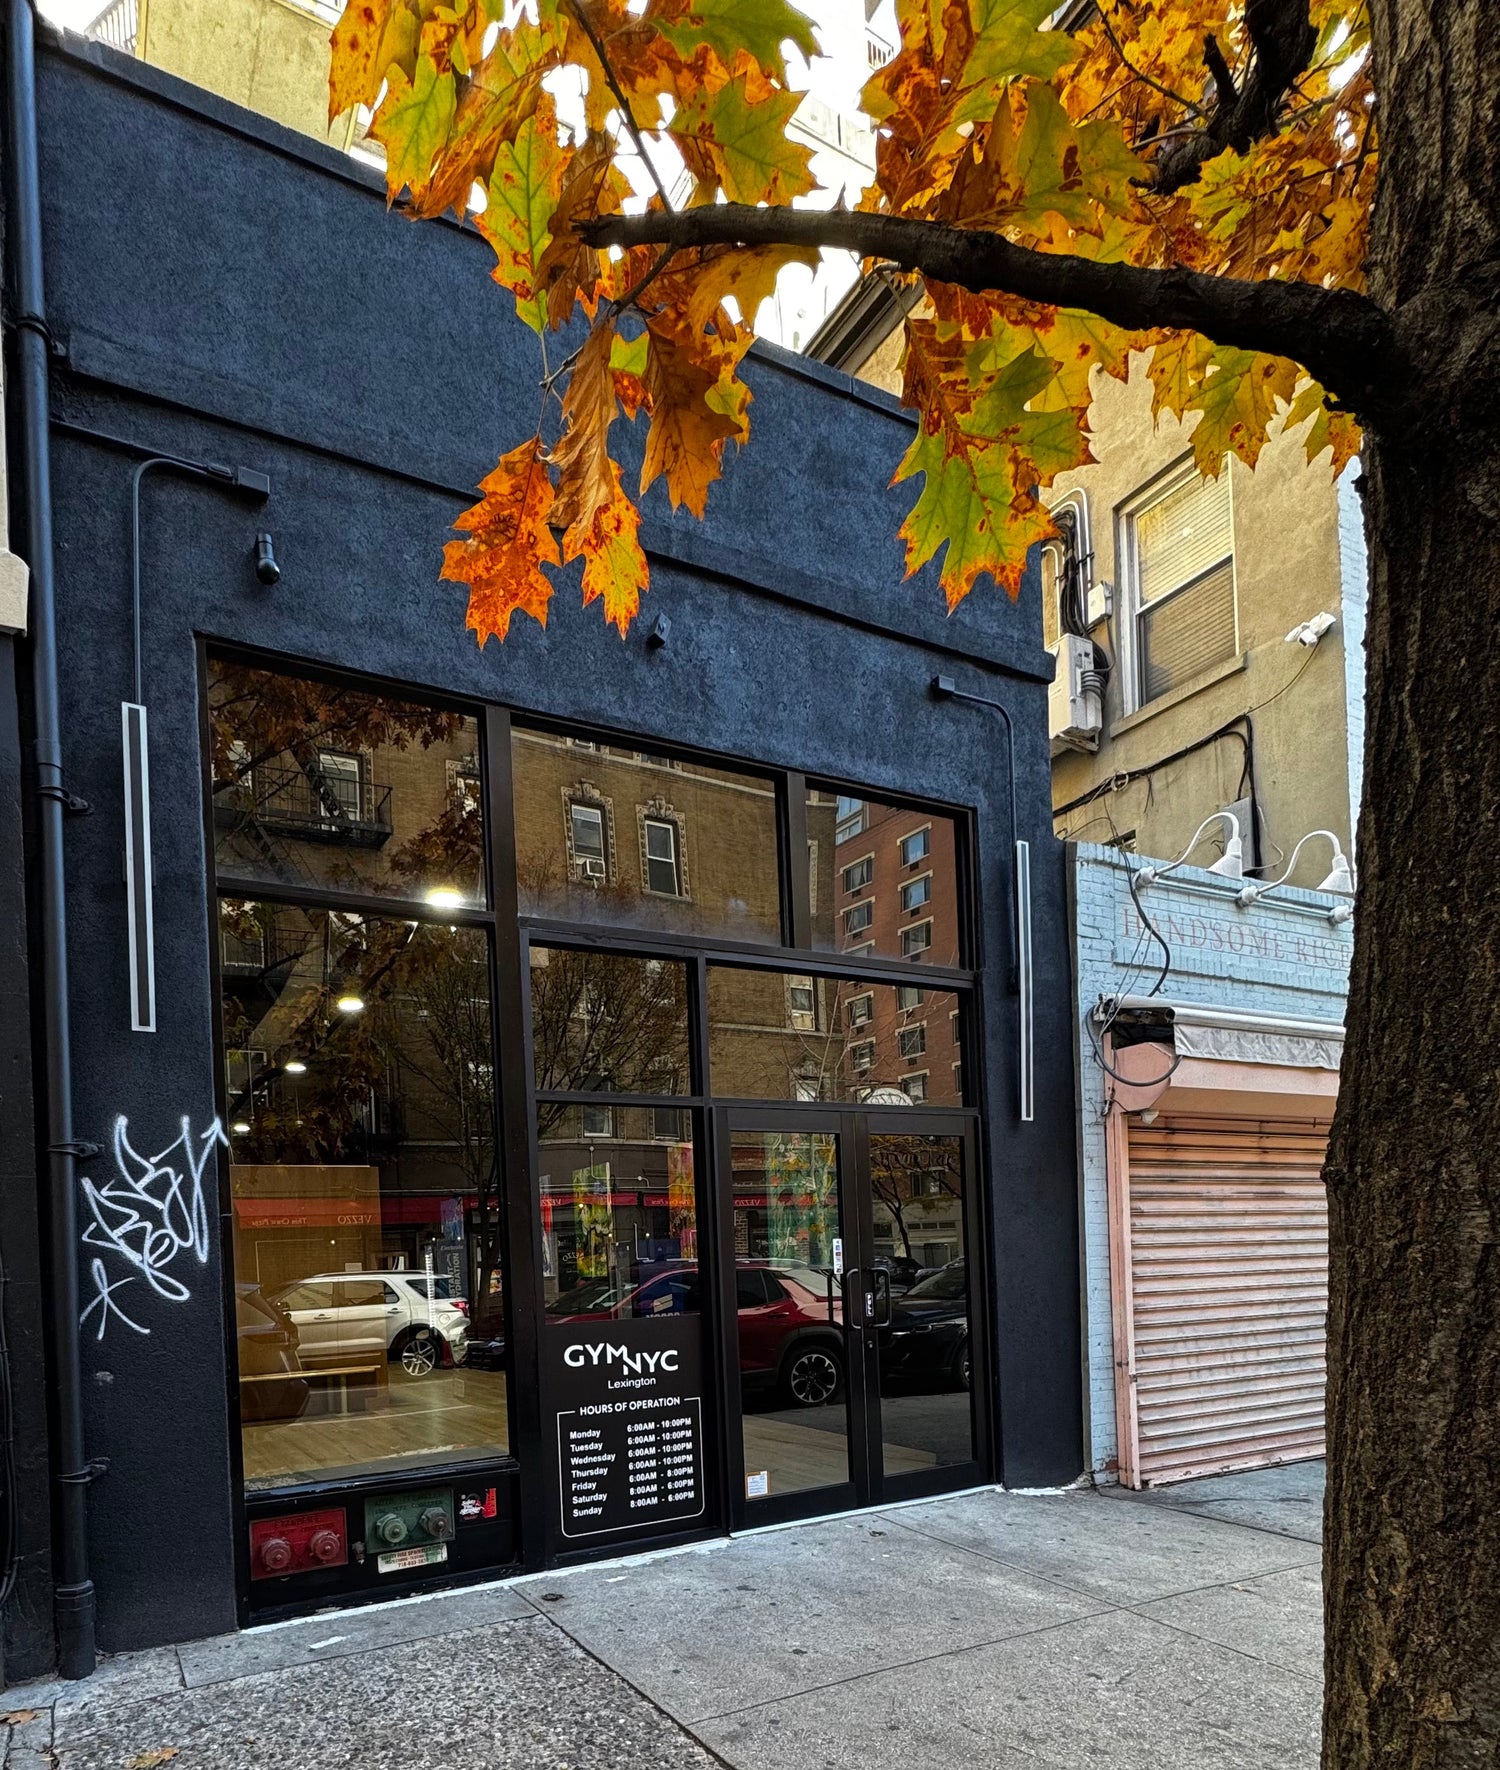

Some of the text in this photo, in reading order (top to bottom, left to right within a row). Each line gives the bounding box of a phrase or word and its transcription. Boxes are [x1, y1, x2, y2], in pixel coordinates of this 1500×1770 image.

[1123, 907, 1351, 969] HANDSOME RICE
[452, 1253, 462, 1298] YDRATION
[608, 1378, 656, 1389] Lexington
[579, 1397, 681, 1416] HOURS OF OPERATION
[569, 1429, 601, 1440] Monday
[627, 1422, 655, 1433] 6:00AM
[661, 1417, 692, 1428] 10:00PM
[570, 1442, 603, 1452] Tuesday
[628, 1434, 656, 1445] 6:00AM
[662, 1430, 692, 1440] 10:00PM
[570, 1453, 616, 1466] Wednesday
[628, 1447, 656, 1457] 6:00AM
[662, 1442, 693, 1453] 10:00PM
[571, 1467, 608, 1478] Thursday
[628, 1459, 657, 1470] 6:00AM
[663, 1454, 693, 1465] 10:00PM
[572, 1481, 597, 1491] Friday
[629, 1472, 657, 1483] 6:00AM
[667, 1466, 694, 1477] 8:00PM
[572, 1493, 607, 1504] Saturday
[629, 1484, 658, 1495] 8:00AM
[667, 1479, 694, 1490] 6:00PM
[573, 1507, 603, 1517] Sunday
[630, 1496, 658, 1508] 8:00AM
[668, 1491, 695, 1502] 6:00PM
